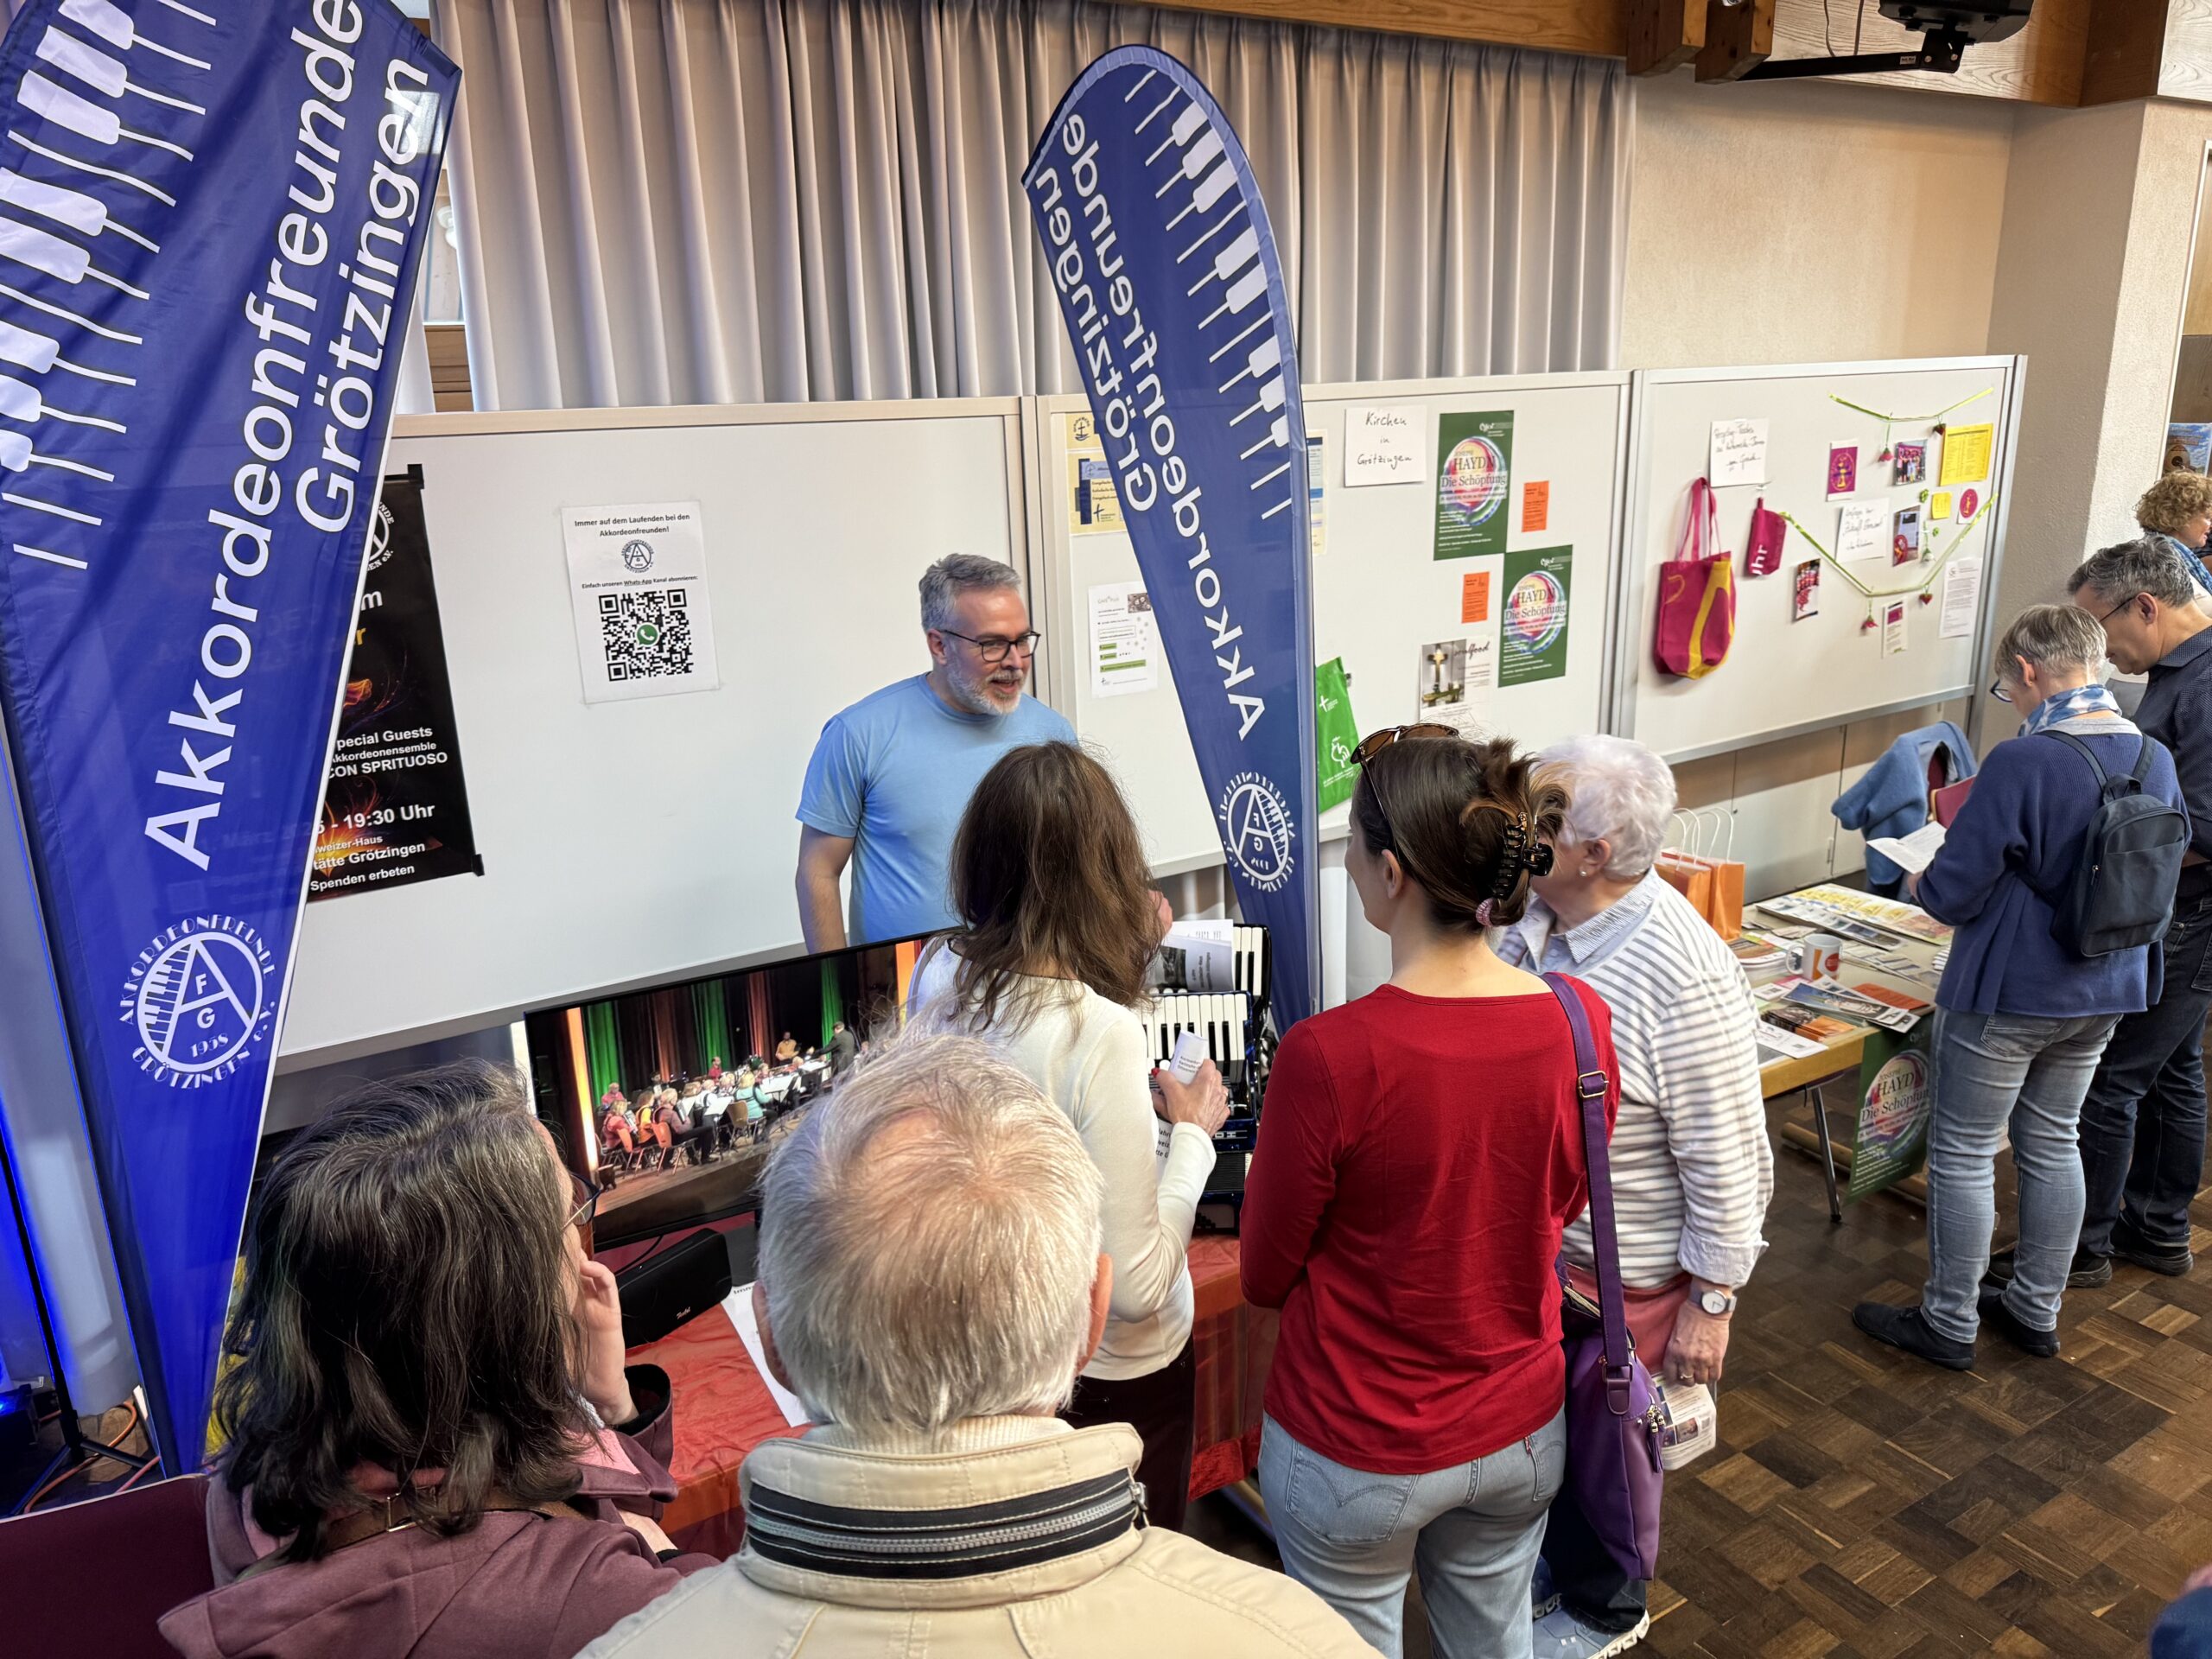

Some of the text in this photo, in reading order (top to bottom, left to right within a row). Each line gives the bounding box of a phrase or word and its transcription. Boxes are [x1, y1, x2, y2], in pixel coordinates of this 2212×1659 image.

[296, 58, 429, 533] Grötzingen
[1365, 411, 1408, 427] Kirchen
[143, 0, 363, 872] Akkordeonfreunde
[1452, 455, 1497, 472] HAYDN
[1440, 472, 1507, 488] Die Schöpfung
[628, 515, 664, 524] Laufenden
[599, 525, 670, 537] Akkordeonfreunden!
[1516, 587, 1555, 605] HAYDN
[335, 727, 434, 751] pecial Guests
[332, 741, 437, 763] kkordeonensemble
[361, 751, 448, 774] SPRITUOSO
[343, 808, 396, 830] 19:30
[400, 804, 436, 821] Uhr
[313, 842, 426, 870] tätte Grötzingen
[315, 836, 384, 854] weizer-Haus
[310, 865, 416, 892] Spenden erbeten
[194, 973, 208, 995] F
[196, 1007, 215, 1029] G
[1860, 1088, 1929, 1122] Die Schöpfun
